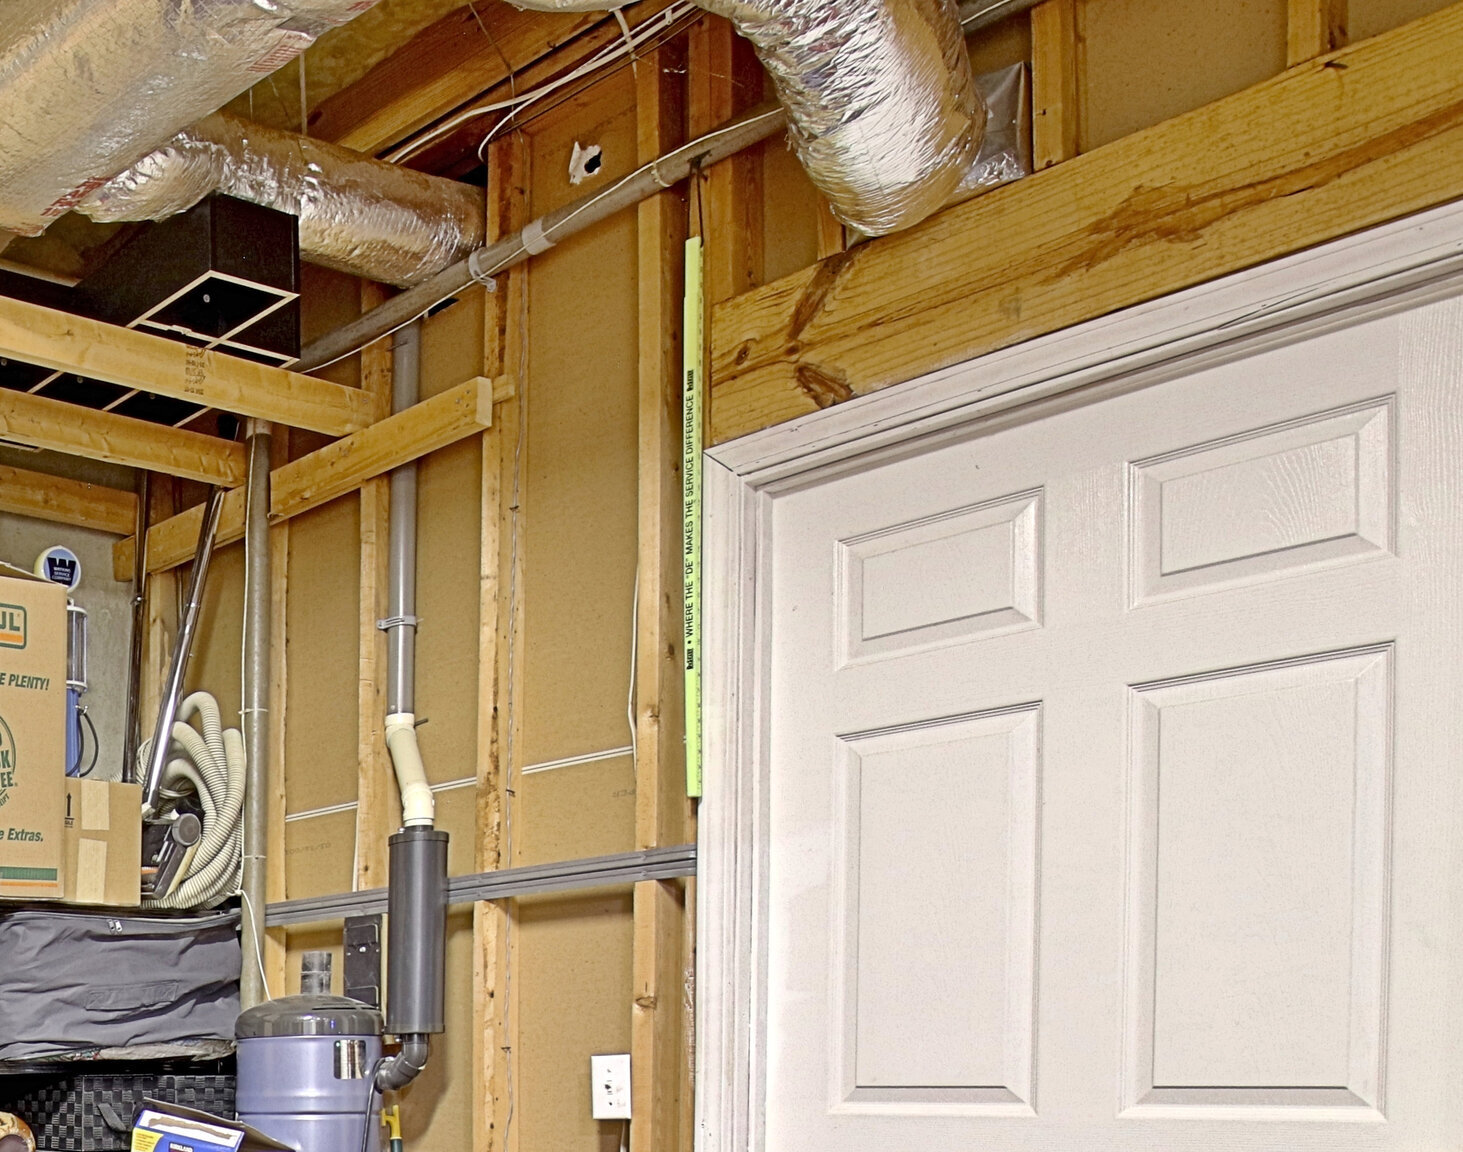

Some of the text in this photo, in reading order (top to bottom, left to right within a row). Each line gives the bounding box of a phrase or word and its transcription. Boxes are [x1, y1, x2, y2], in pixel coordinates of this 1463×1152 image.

[686, 394, 694, 453] DIFFERENCE
[686, 456, 694, 497] SERVICE
[686, 500, 694, 519] THE
[686, 520, 694, 554] MAKES
[686, 581, 694, 600] THE
[686, 602, 694, 638] WHERE
[8, 675, 50, 690] PLENTY!
[8, 828, 44, 842] Extras.
